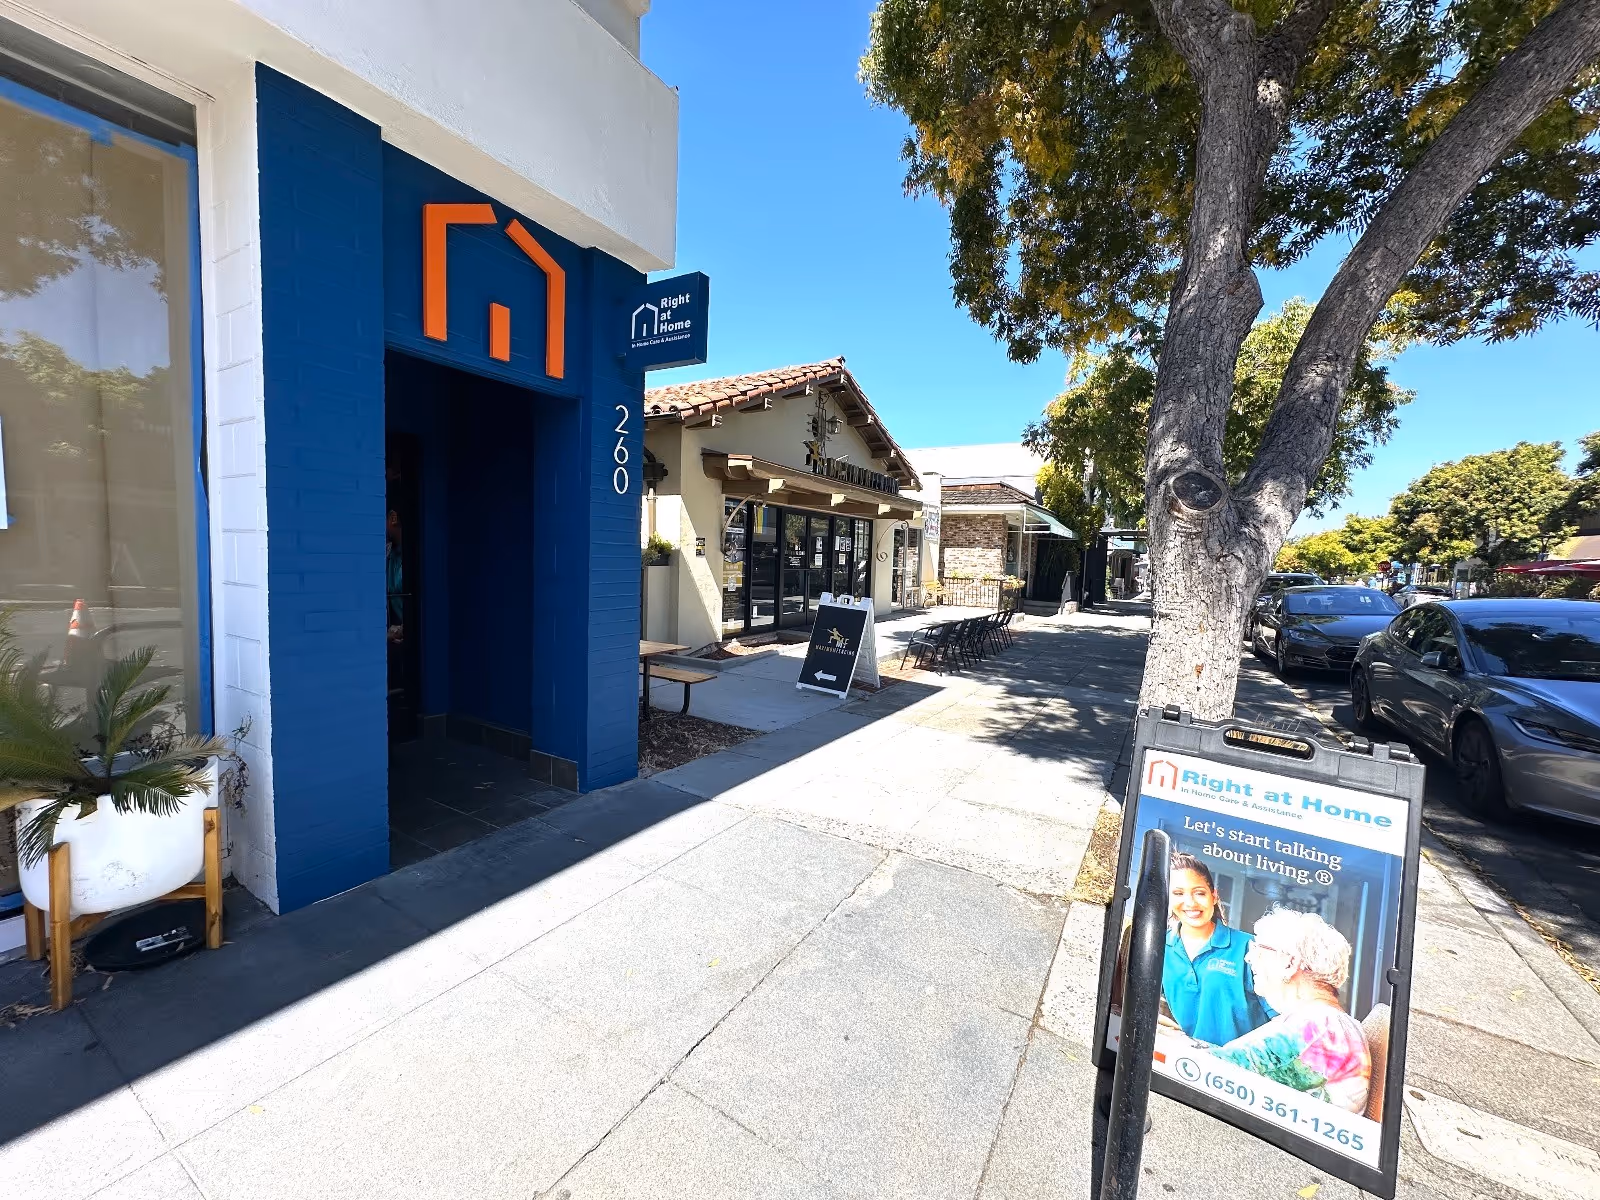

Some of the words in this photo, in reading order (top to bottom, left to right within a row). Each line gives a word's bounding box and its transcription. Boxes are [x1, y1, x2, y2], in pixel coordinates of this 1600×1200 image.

[660, 309, 671, 320] at
[661, 293, 690, 308] Right
[660, 320, 691, 333] Home
[613, 405, 629, 494] 260
[1182, 769, 1253, 796] Right
[1264, 791, 1292, 805] at
[1302, 795, 1392, 827] Home
[1192, 789, 1216, 799] Home
[1219, 795, 1239, 804] Care
[1251, 803, 1304, 819] Assistance
[1184, 816, 1224, 838] Let's
[1229, 827, 1271, 850] start
[1275, 840, 1342, 871] talking
[1203, 842, 1252, 866] about
[1205, 1071, 1255, 1105] (650)
[1262, 1096, 1364, 1151] 361-1265
